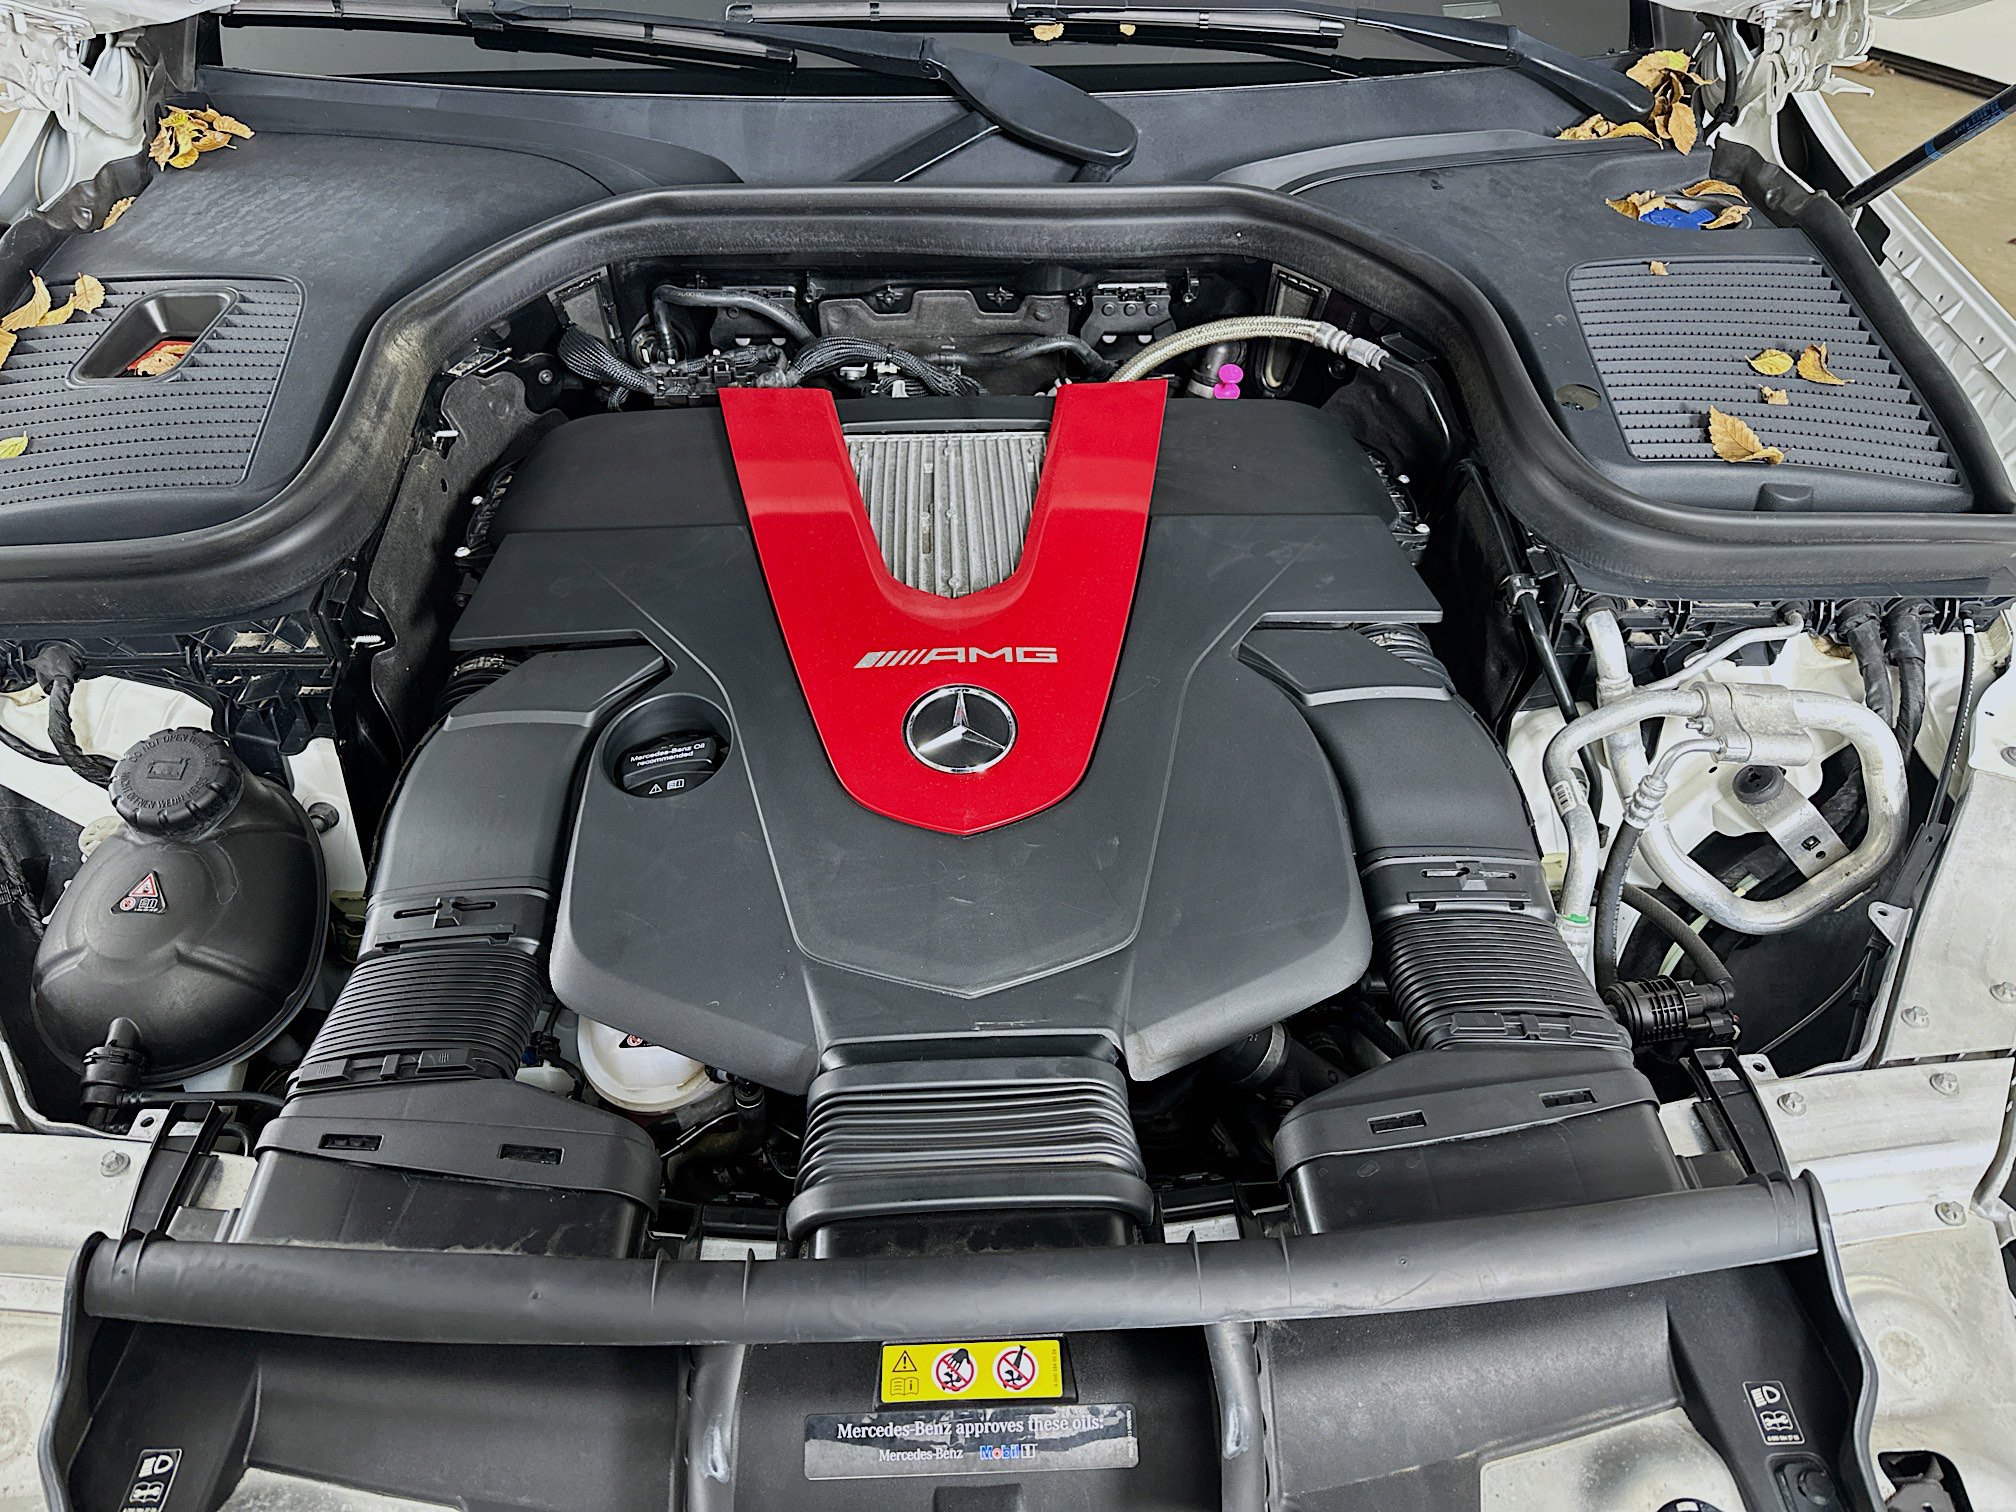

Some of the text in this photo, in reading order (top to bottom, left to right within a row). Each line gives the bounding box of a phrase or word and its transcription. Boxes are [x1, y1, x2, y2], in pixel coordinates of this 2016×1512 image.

[919, 647, 1059, 665] AMG
[129, 751, 142, 763] DO
[142, 739, 160, 752] NOT
[163, 734, 189, 744] OPEN
[630, 742, 706, 762] Mercedes-Benz Oil
[636, 751, 694, 767] recommended
[837, 1414, 1104, 1439] Mercedes-Benz approves these oils:
[879, 1447, 963, 1462] Mercedes-Benz
[979, 1444, 1021, 1461] Mobil
